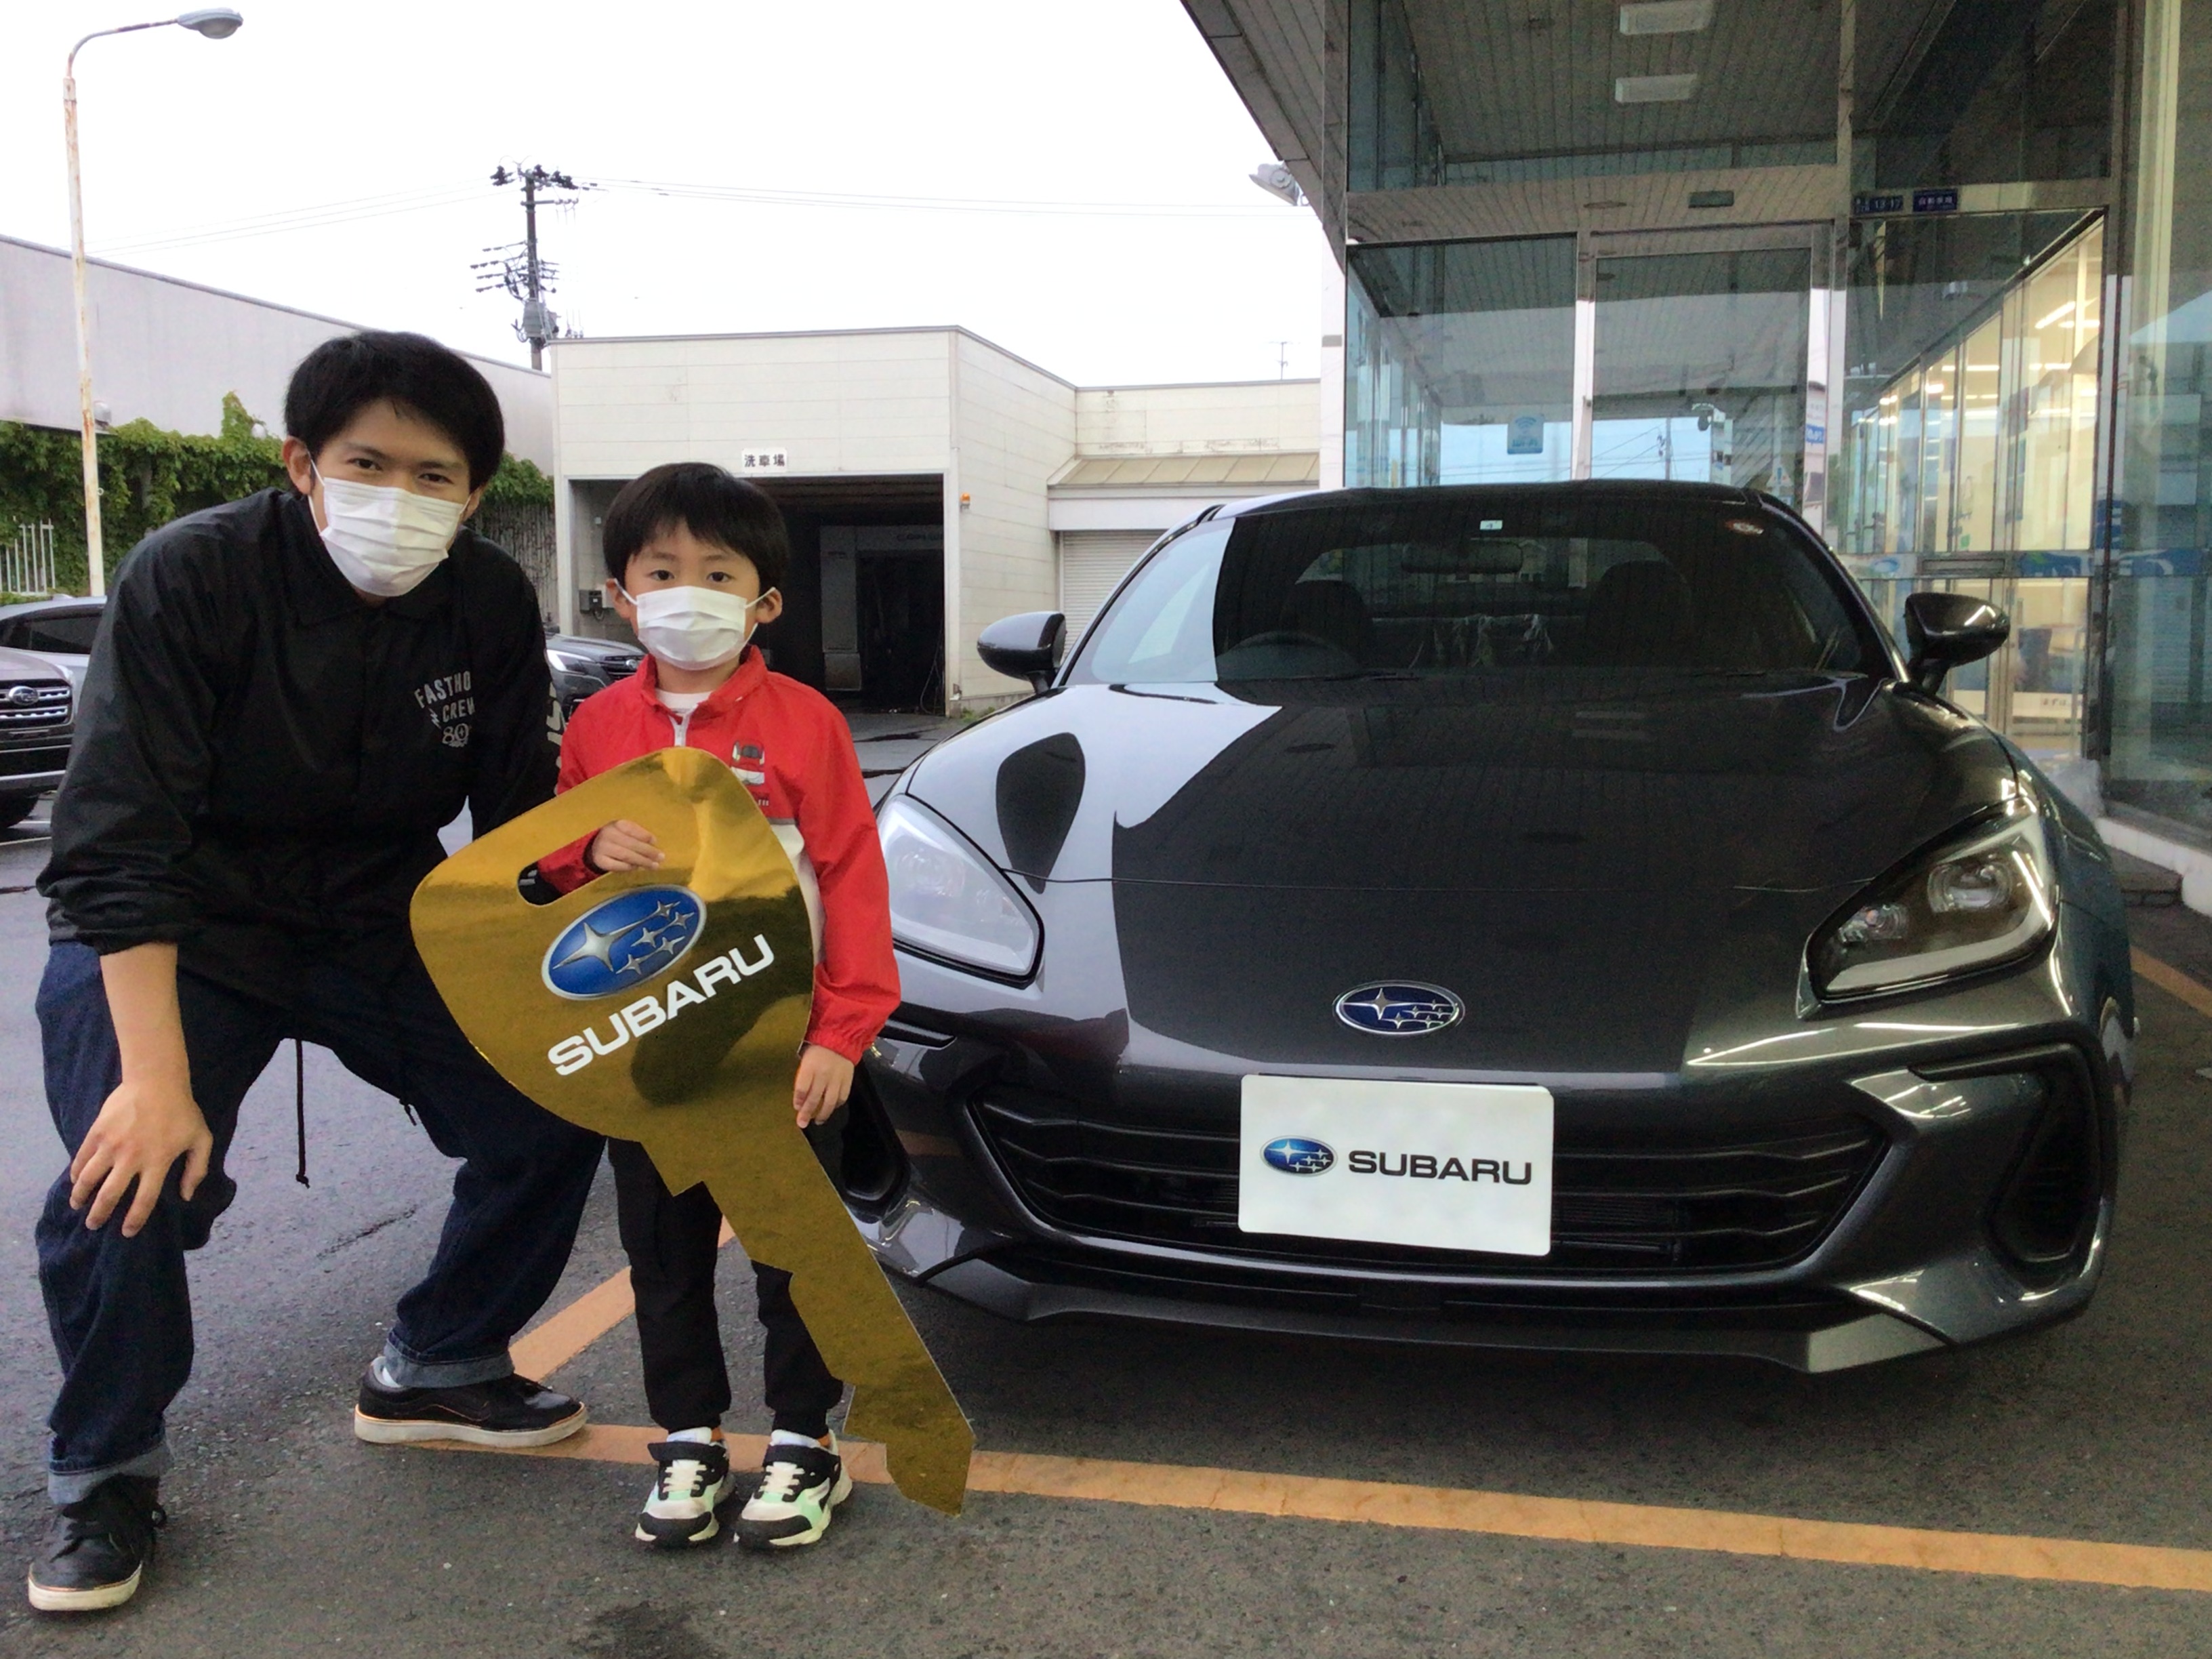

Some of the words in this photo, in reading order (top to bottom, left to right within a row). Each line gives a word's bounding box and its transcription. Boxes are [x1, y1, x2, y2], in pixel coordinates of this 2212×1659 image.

[744, 453, 785, 468] 洗車場
[548, 933, 775, 1076] SUBARU
[1348, 1149, 1532, 1186] SUBARU
